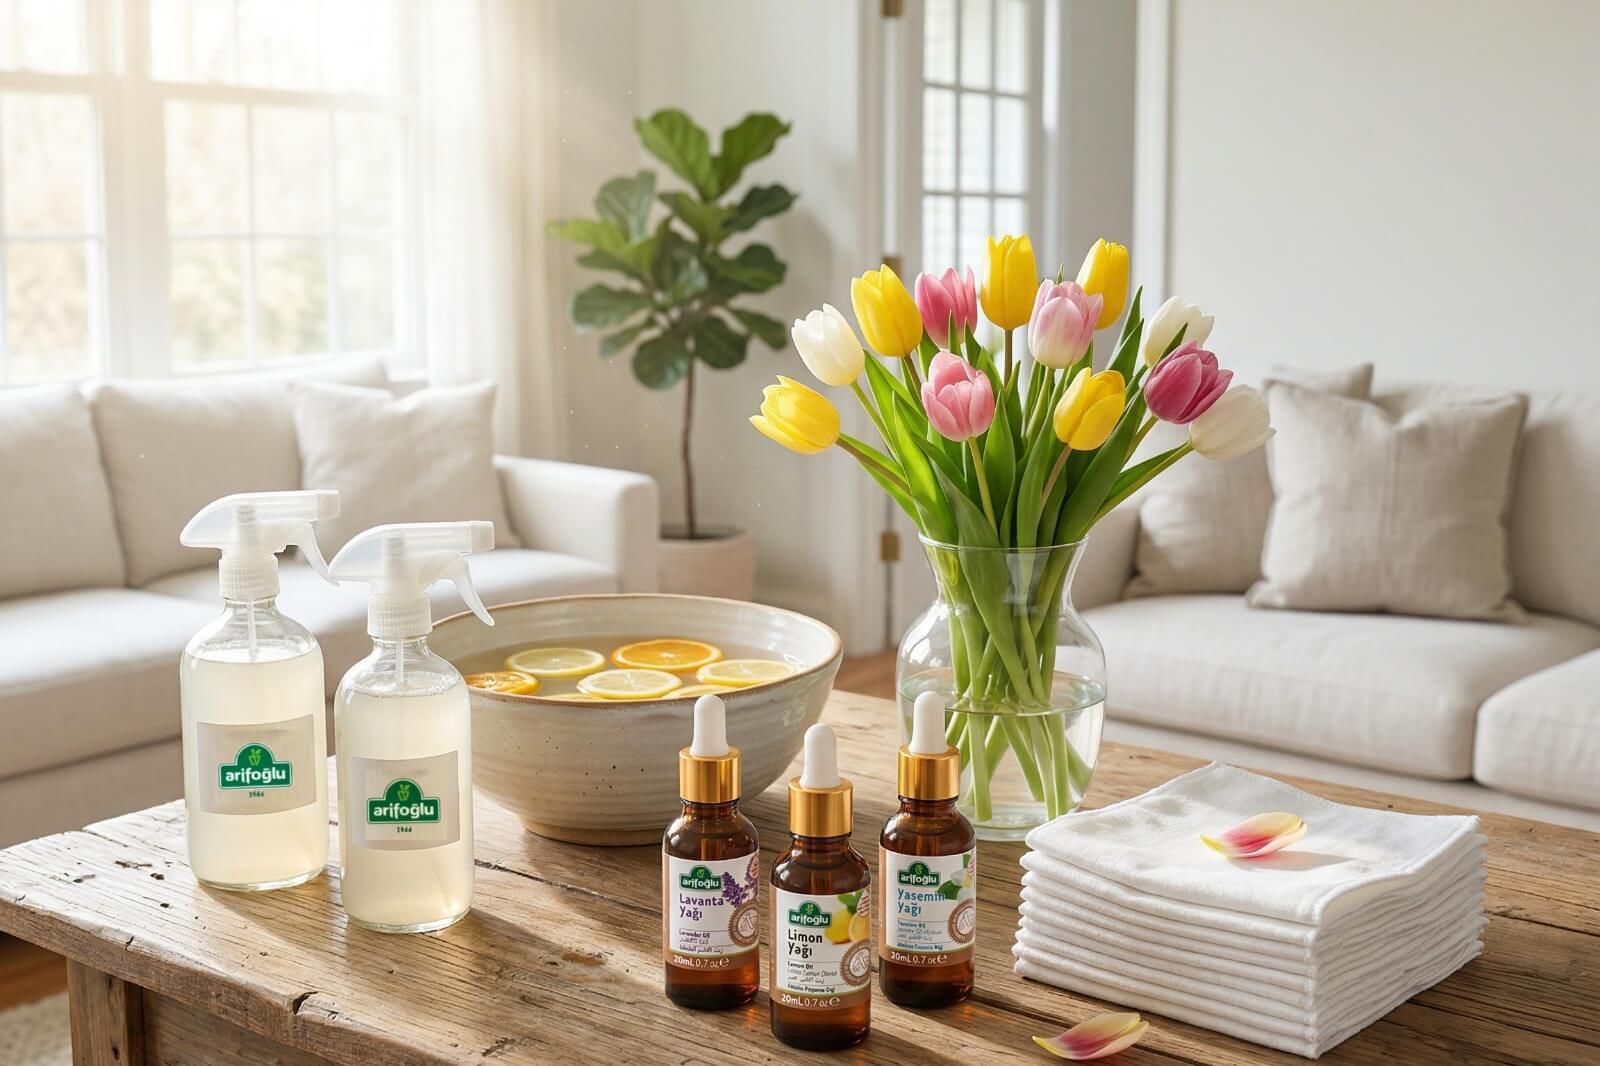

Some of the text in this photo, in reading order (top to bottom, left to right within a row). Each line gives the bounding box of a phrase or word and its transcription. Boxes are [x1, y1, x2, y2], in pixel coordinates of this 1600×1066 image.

[225, 766, 286, 784] arifoğlu
[373, 802, 435, 819] arifoğlu
[679, 893, 725, 907] Lavanta
[897, 887, 945, 902] Yasemin
[679, 905, 703, 921] Yağı
[897, 901, 921, 917] Yağı
[787, 928, 823, 944] Limon
[787, 941, 813, 959] Yağı
[890, 951, 912, 963] 20mL
[912, 955, 926, 964] 0.7
[673, 954, 695, 967] 20mL
[695, 958, 709, 968] 0.7
[781, 993, 804, 1006] 20mL
[804, 998, 818, 1007] 0.7
